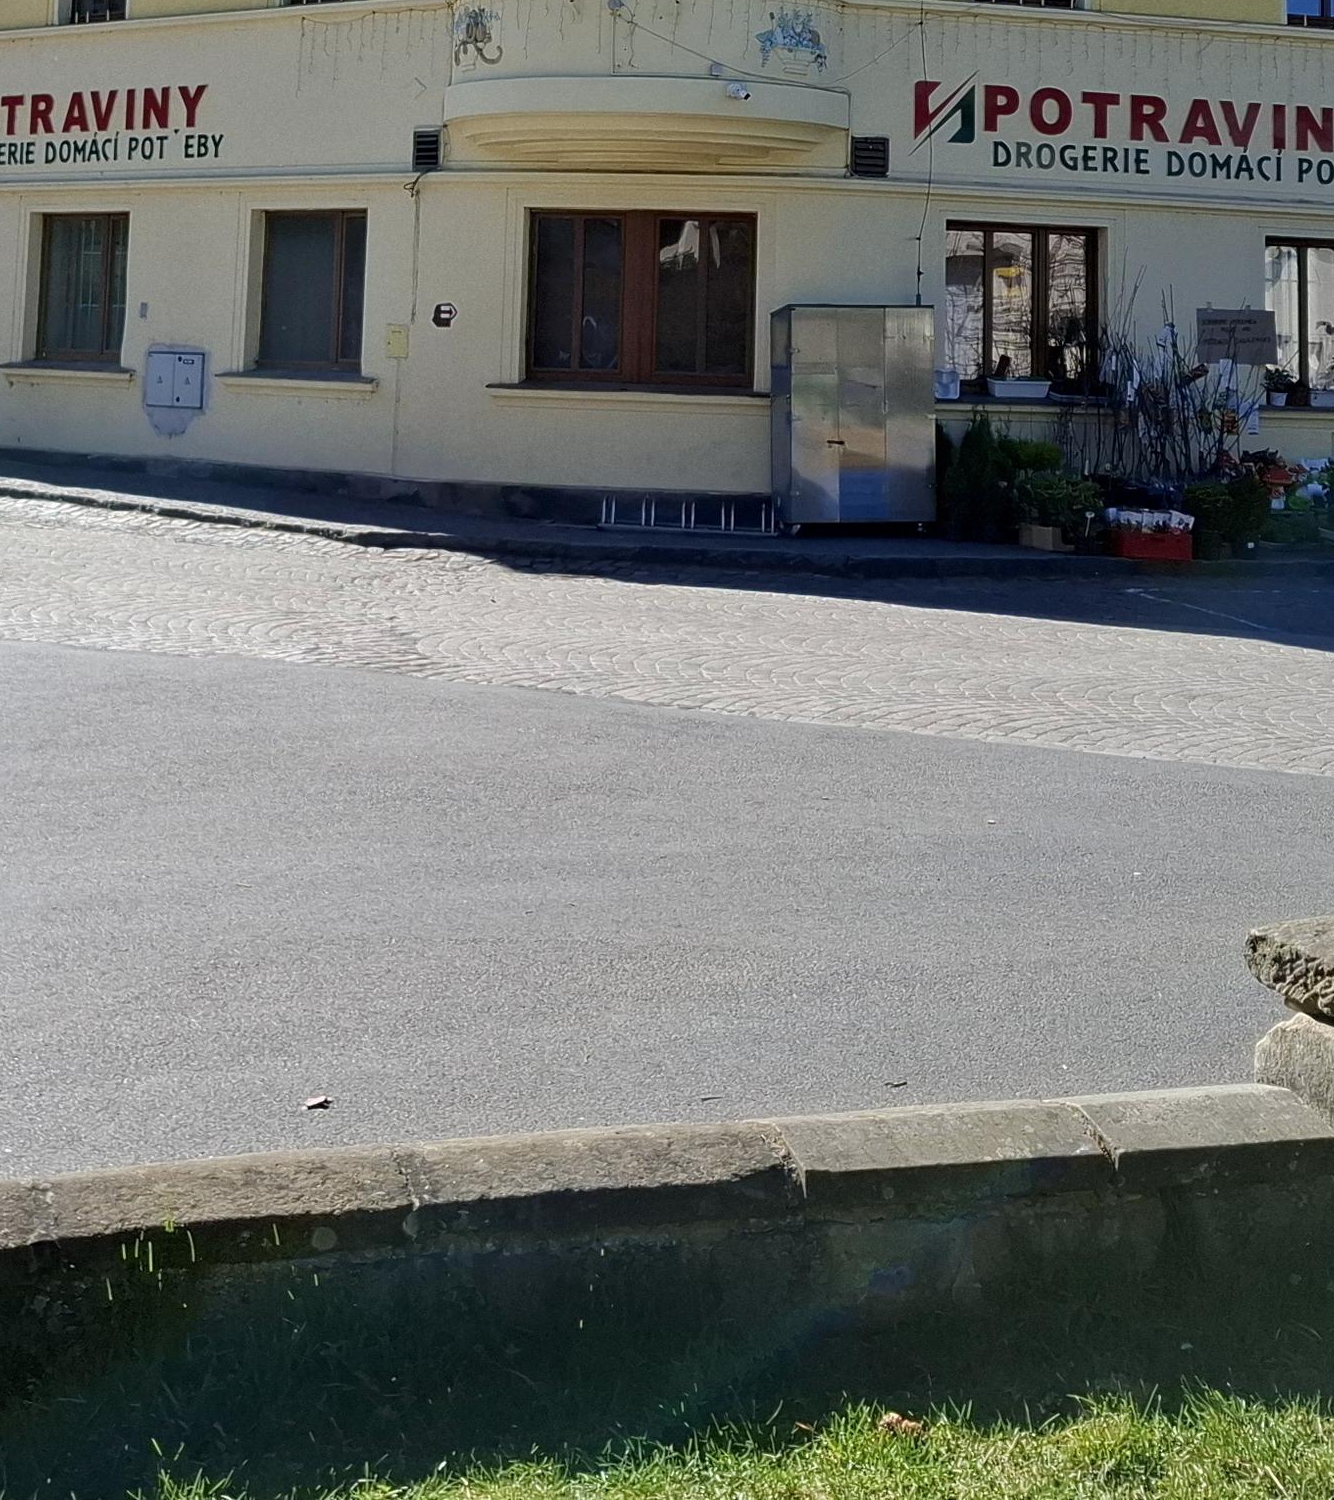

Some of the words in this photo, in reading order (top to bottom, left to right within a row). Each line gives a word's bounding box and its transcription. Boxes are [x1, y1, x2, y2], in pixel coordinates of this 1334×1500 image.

[44, 131, 120, 164] DOMÁCÍ
[127, 129, 224, 160] POTEBY
[992, 140, 1150, 175] DROGERIE
[1167, 148, 1282, 181] DOMÁCÍ
